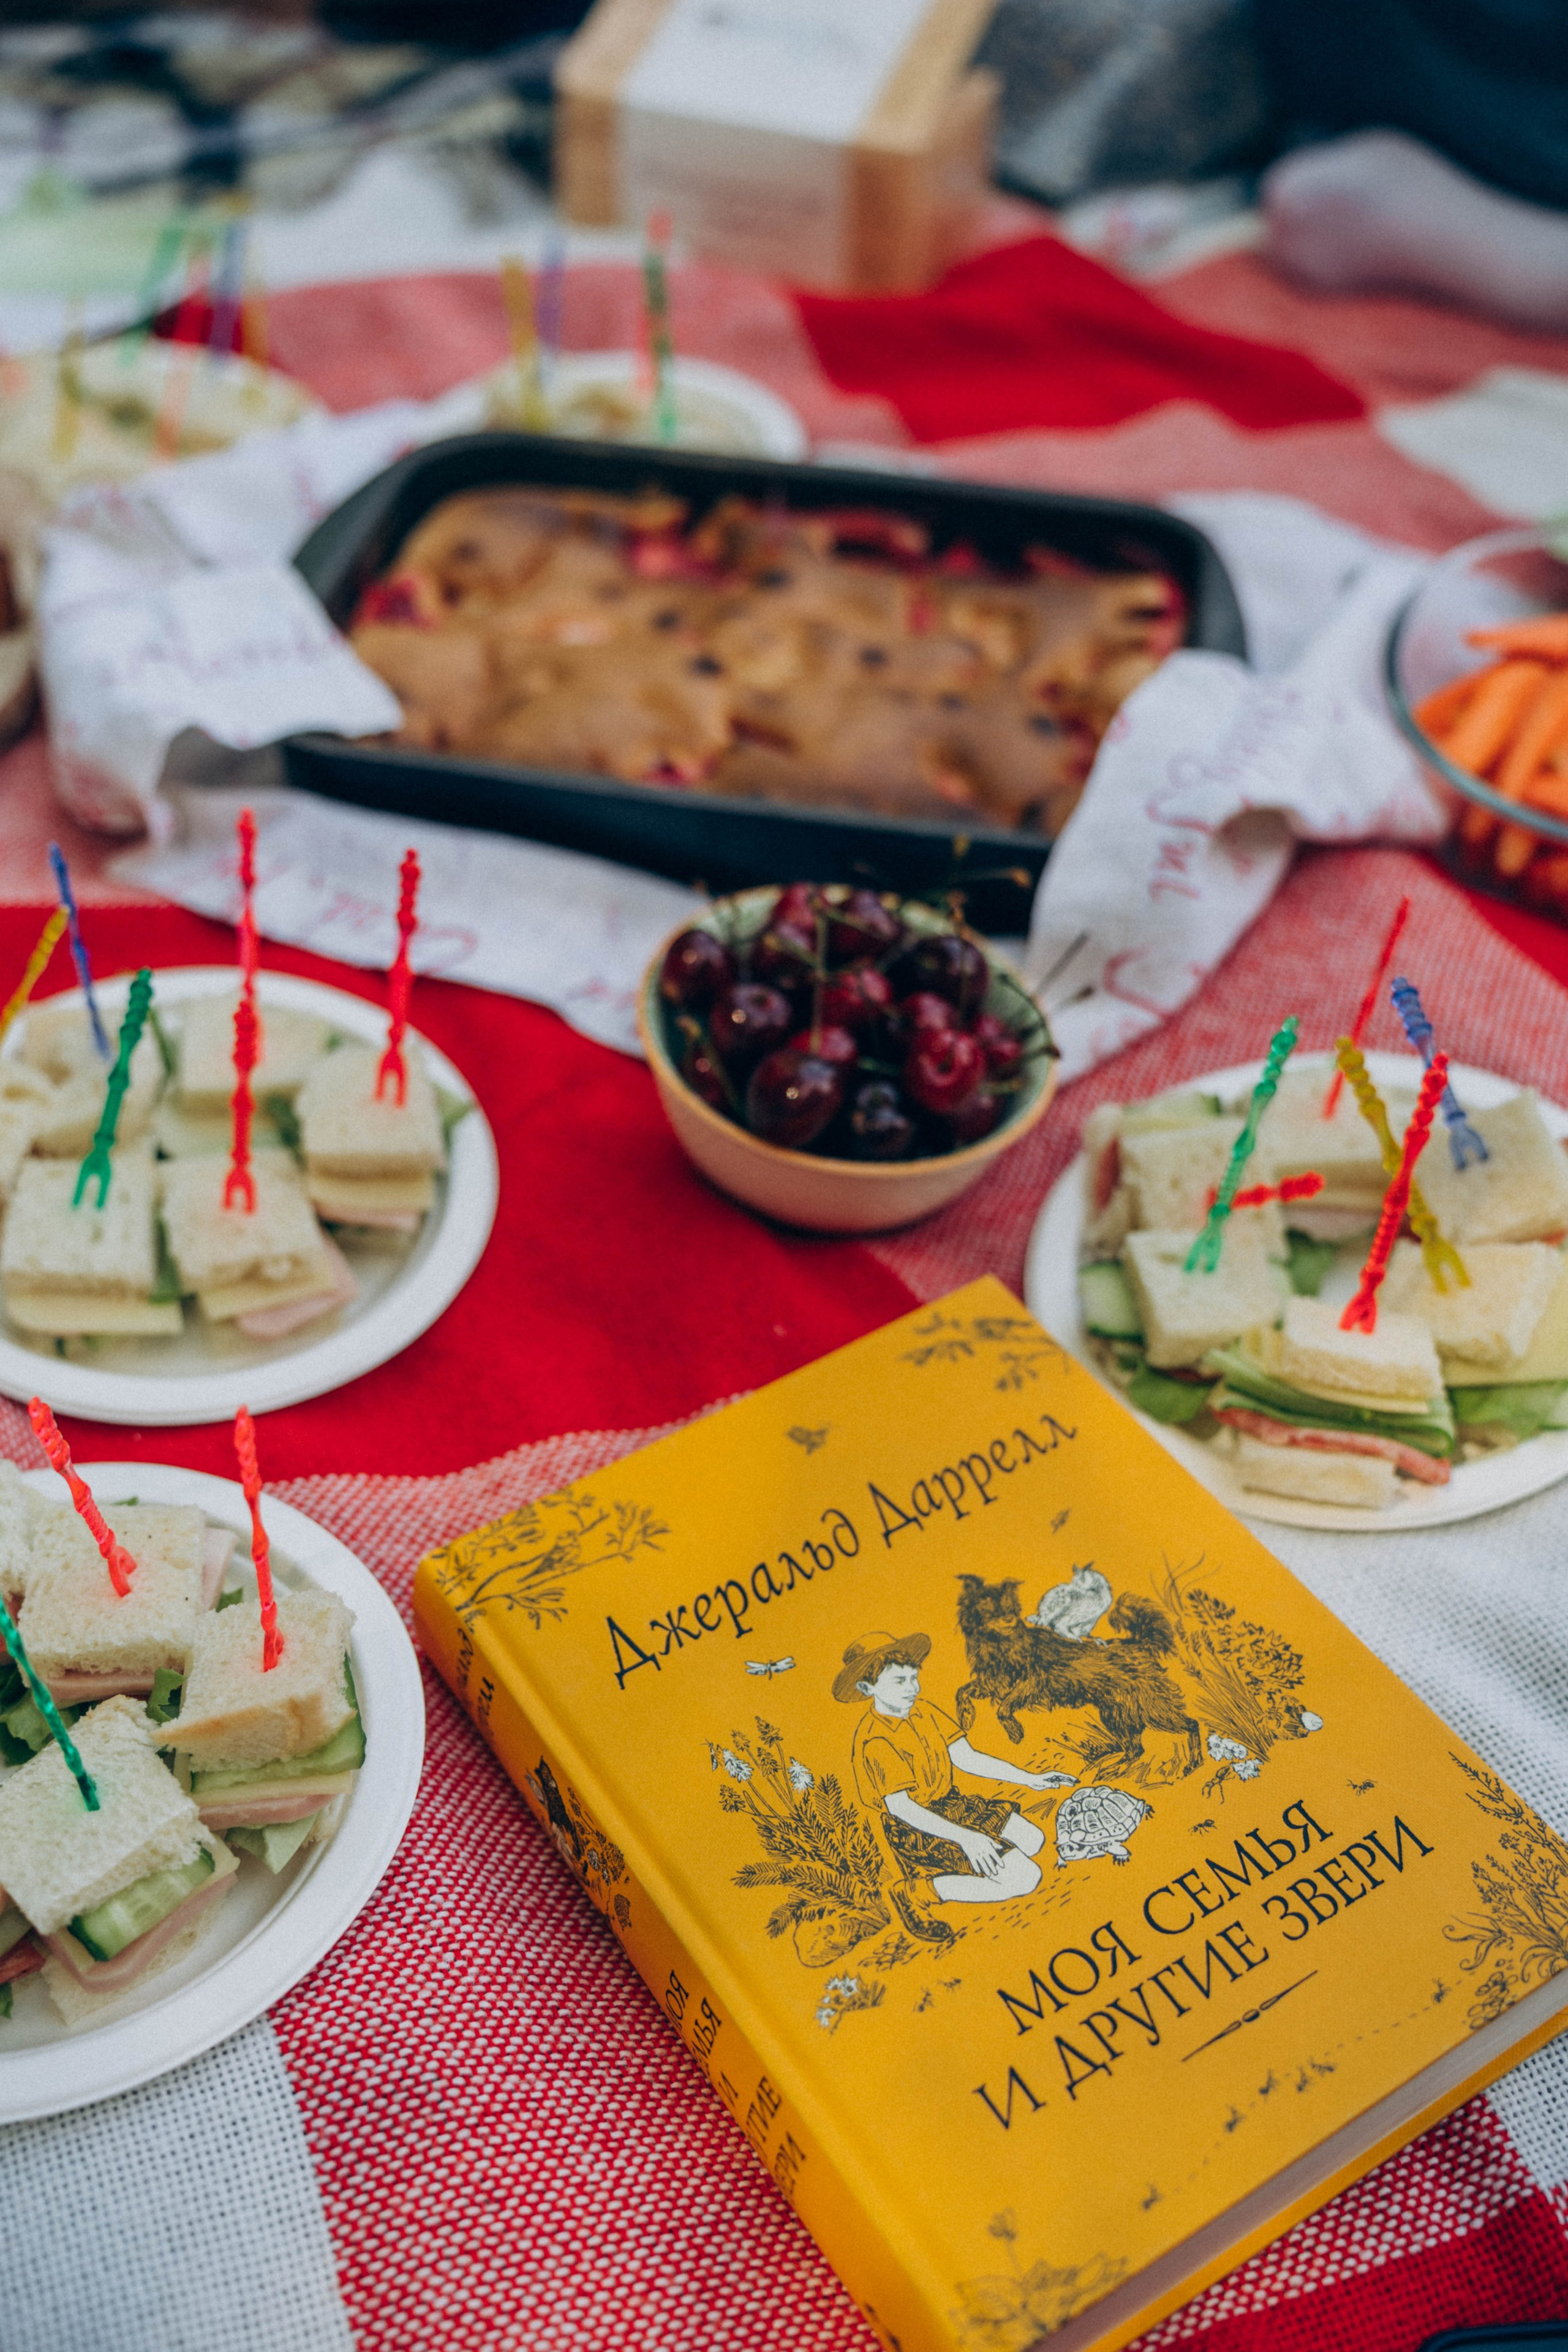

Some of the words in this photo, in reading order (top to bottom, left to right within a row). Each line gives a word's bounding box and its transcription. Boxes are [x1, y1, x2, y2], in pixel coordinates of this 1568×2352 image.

[605, 1508, 859, 1691] Джеральд
[868, 1413, 1077, 1548] Даррелл
[692, 1997, 722, 2075] МЬЯ
[973, 2065, 1046, 2130] И
[1054, 1920, 1269, 2101] ДРУГИЕ
[1261, 1815, 1434, 1942] ЗВЕРИ
[996, 1920, 1142, 2036] МОЯ
[1143, 1799, 1334, 1935] СЕМЬЯ
